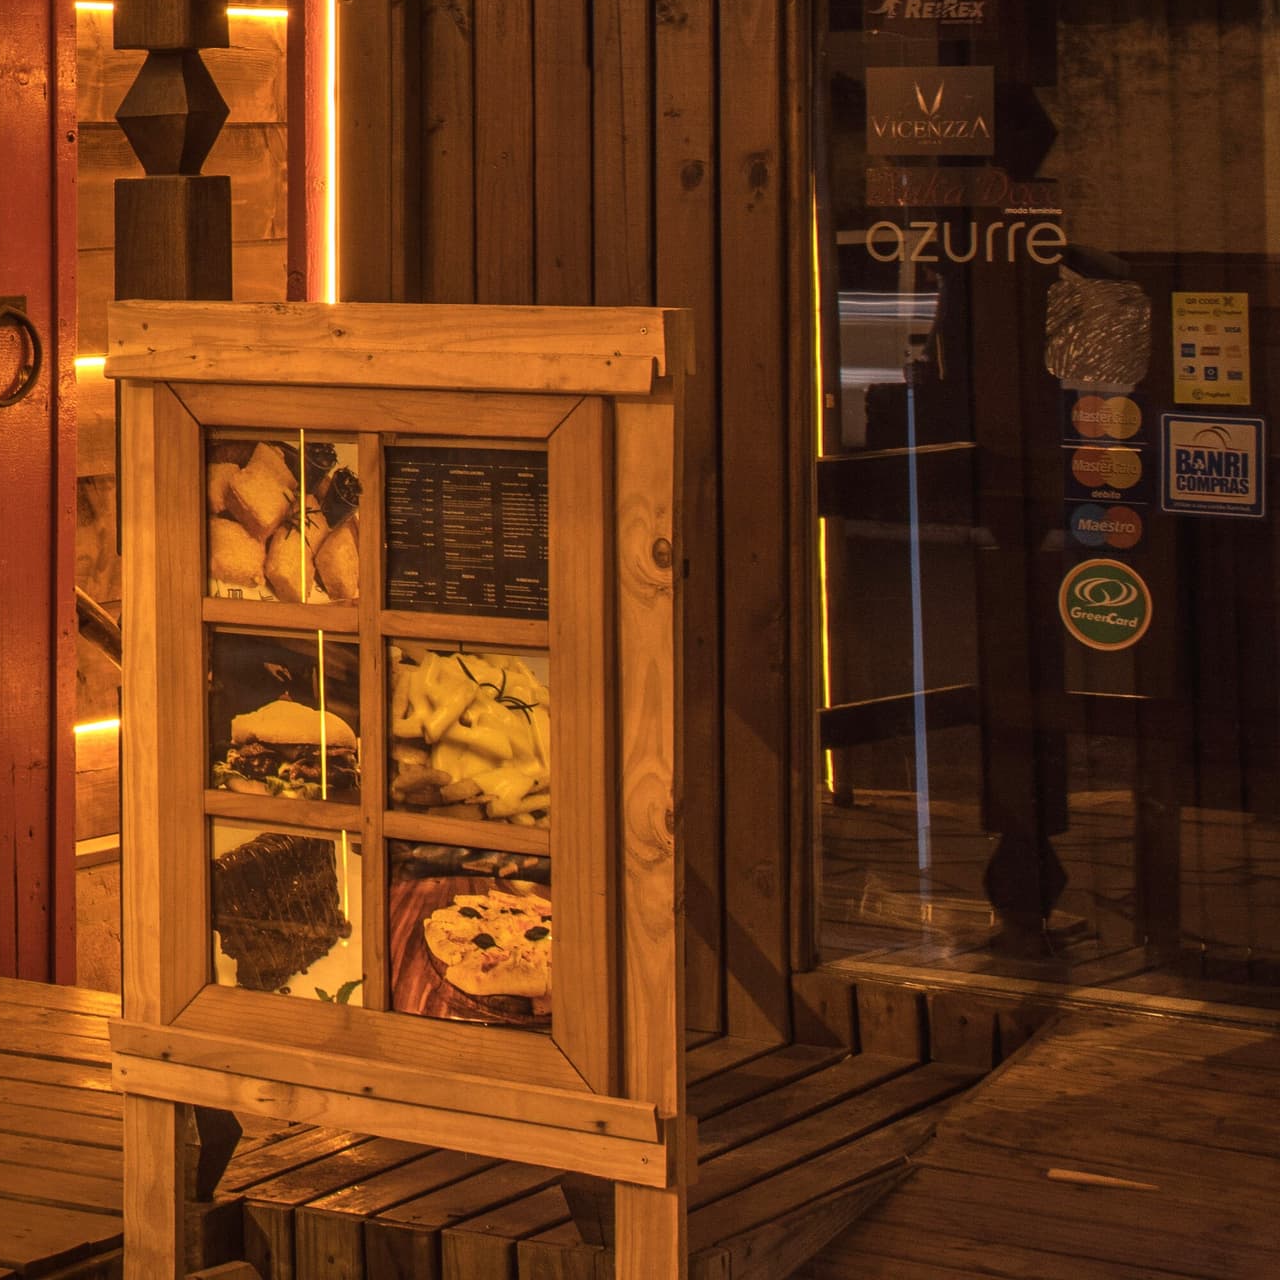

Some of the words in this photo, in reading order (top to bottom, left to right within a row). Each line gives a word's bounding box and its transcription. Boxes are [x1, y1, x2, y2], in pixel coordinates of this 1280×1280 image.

[866, 220, 1068, 265] azurre
[1175, 448, 1249, 478] BANRI
[1176, 475, 1249, 495] COMPRAS
[1077, 518, 1136, 533] Maestro
[1070, 605, 1139, 629] GreenCard
